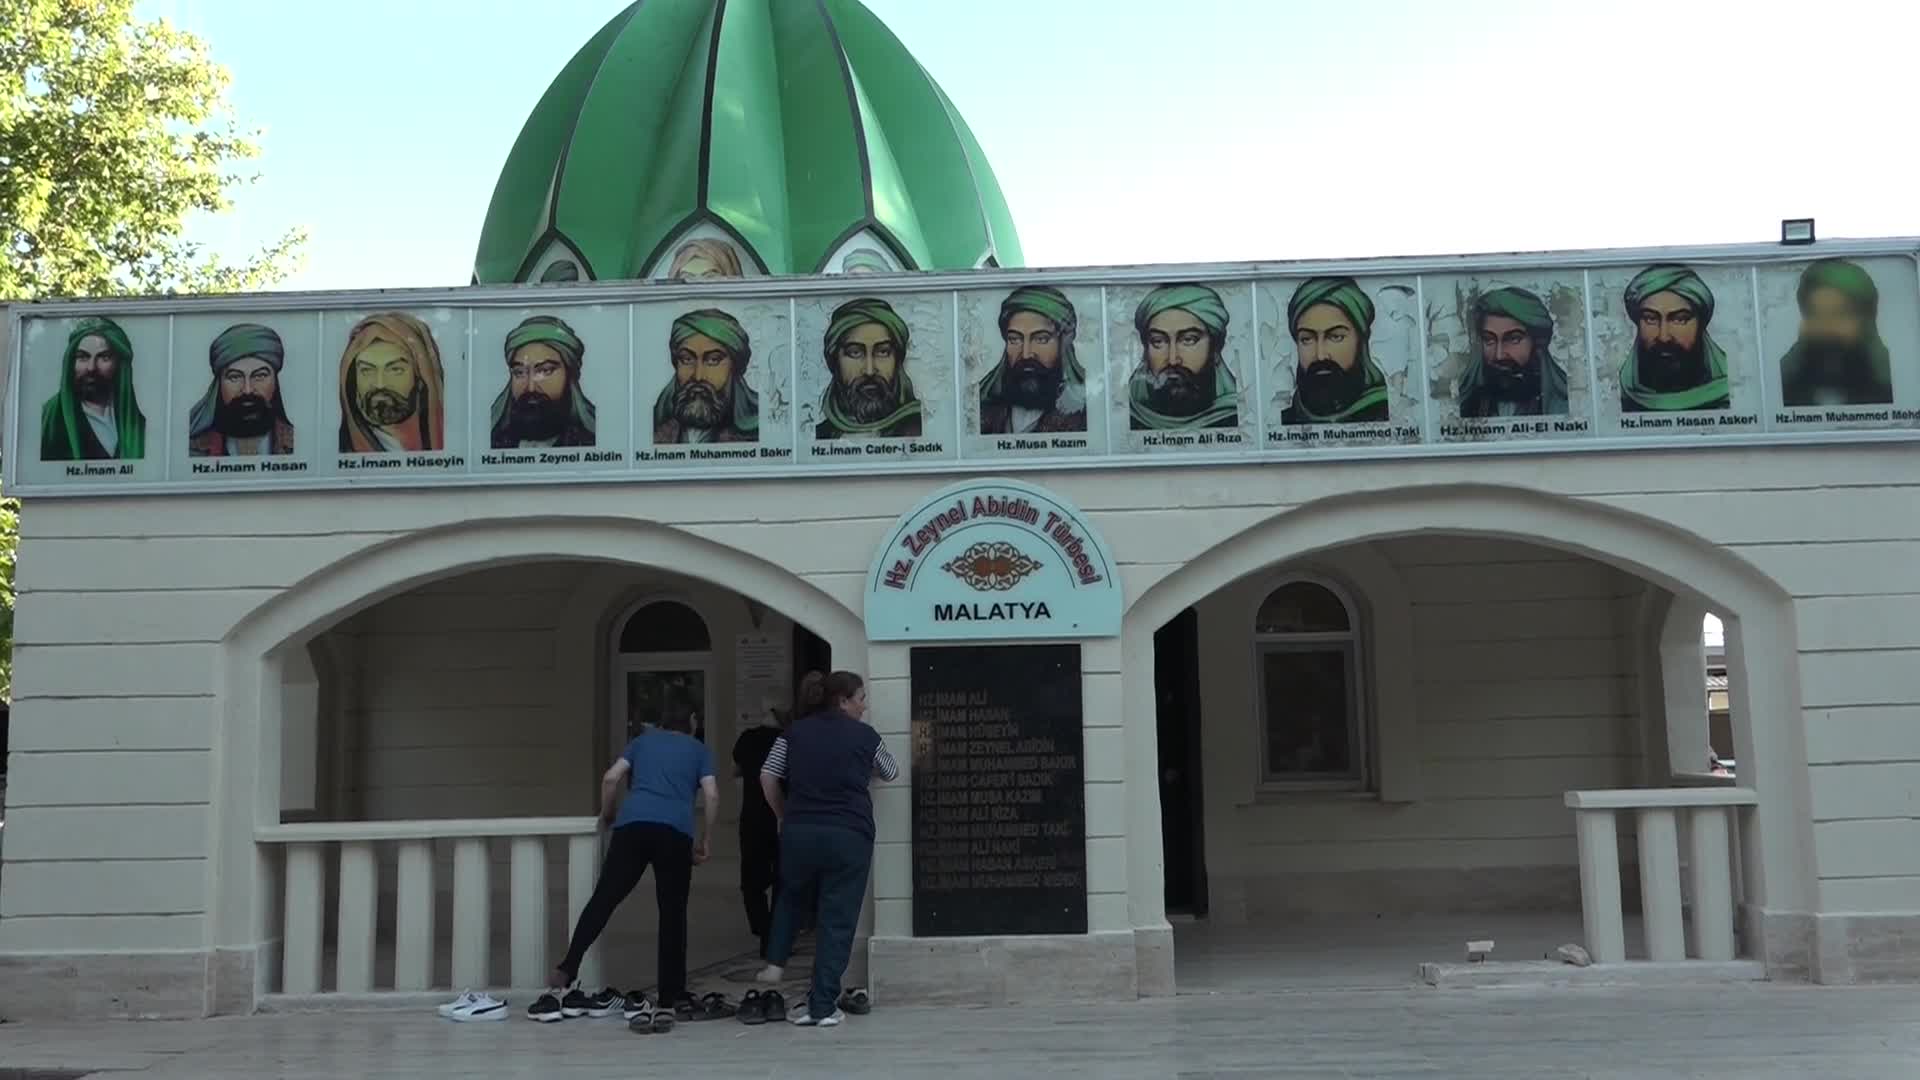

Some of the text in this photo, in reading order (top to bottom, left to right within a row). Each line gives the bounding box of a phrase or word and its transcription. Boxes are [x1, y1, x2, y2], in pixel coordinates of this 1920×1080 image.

[884, 496, 1102, 589] Hz. Zeynel Abidin Türbesi
[934, 602, 1051, 621] MALATYA
